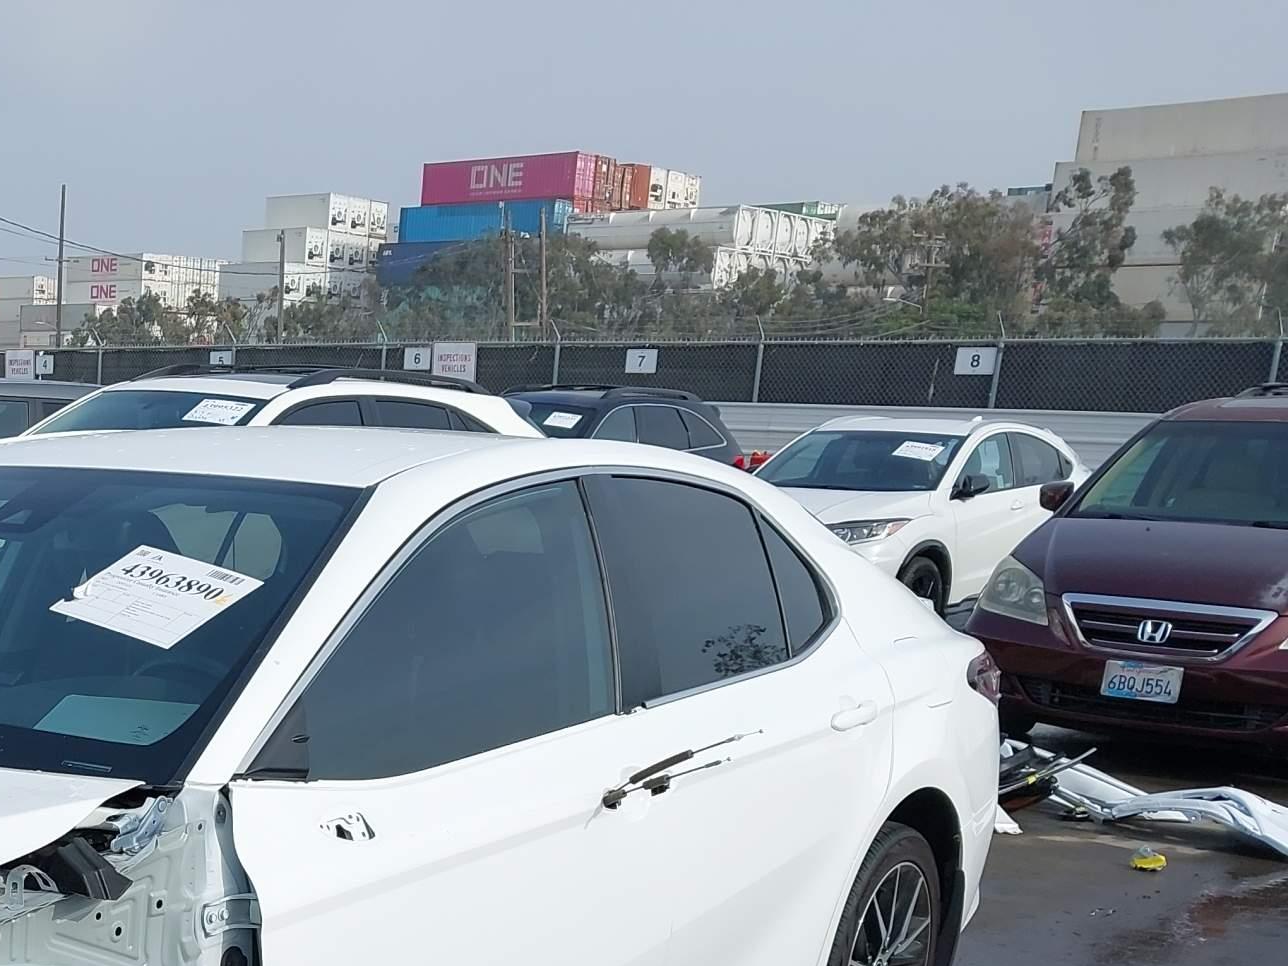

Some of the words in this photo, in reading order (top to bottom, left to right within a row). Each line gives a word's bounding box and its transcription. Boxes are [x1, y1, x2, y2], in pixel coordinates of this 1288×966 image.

[470, 162, 524, 189] ONE
[91, 258, 118, 273] ONE
[90, 284, 117, 299] ONE
[42, 359, 48, 370] 4
[414, 353, 421, 365] 6
[438, 353, 472, 362] INSPECTIONS
[638, 355, 646, 367] 7
[970, 354, 981, 368] 8
[441, 364, 466, 373] VEHICLES
[121, 563, 225, 600] 43963890
[1107, 674, 1172, 697] 6BQJ554
